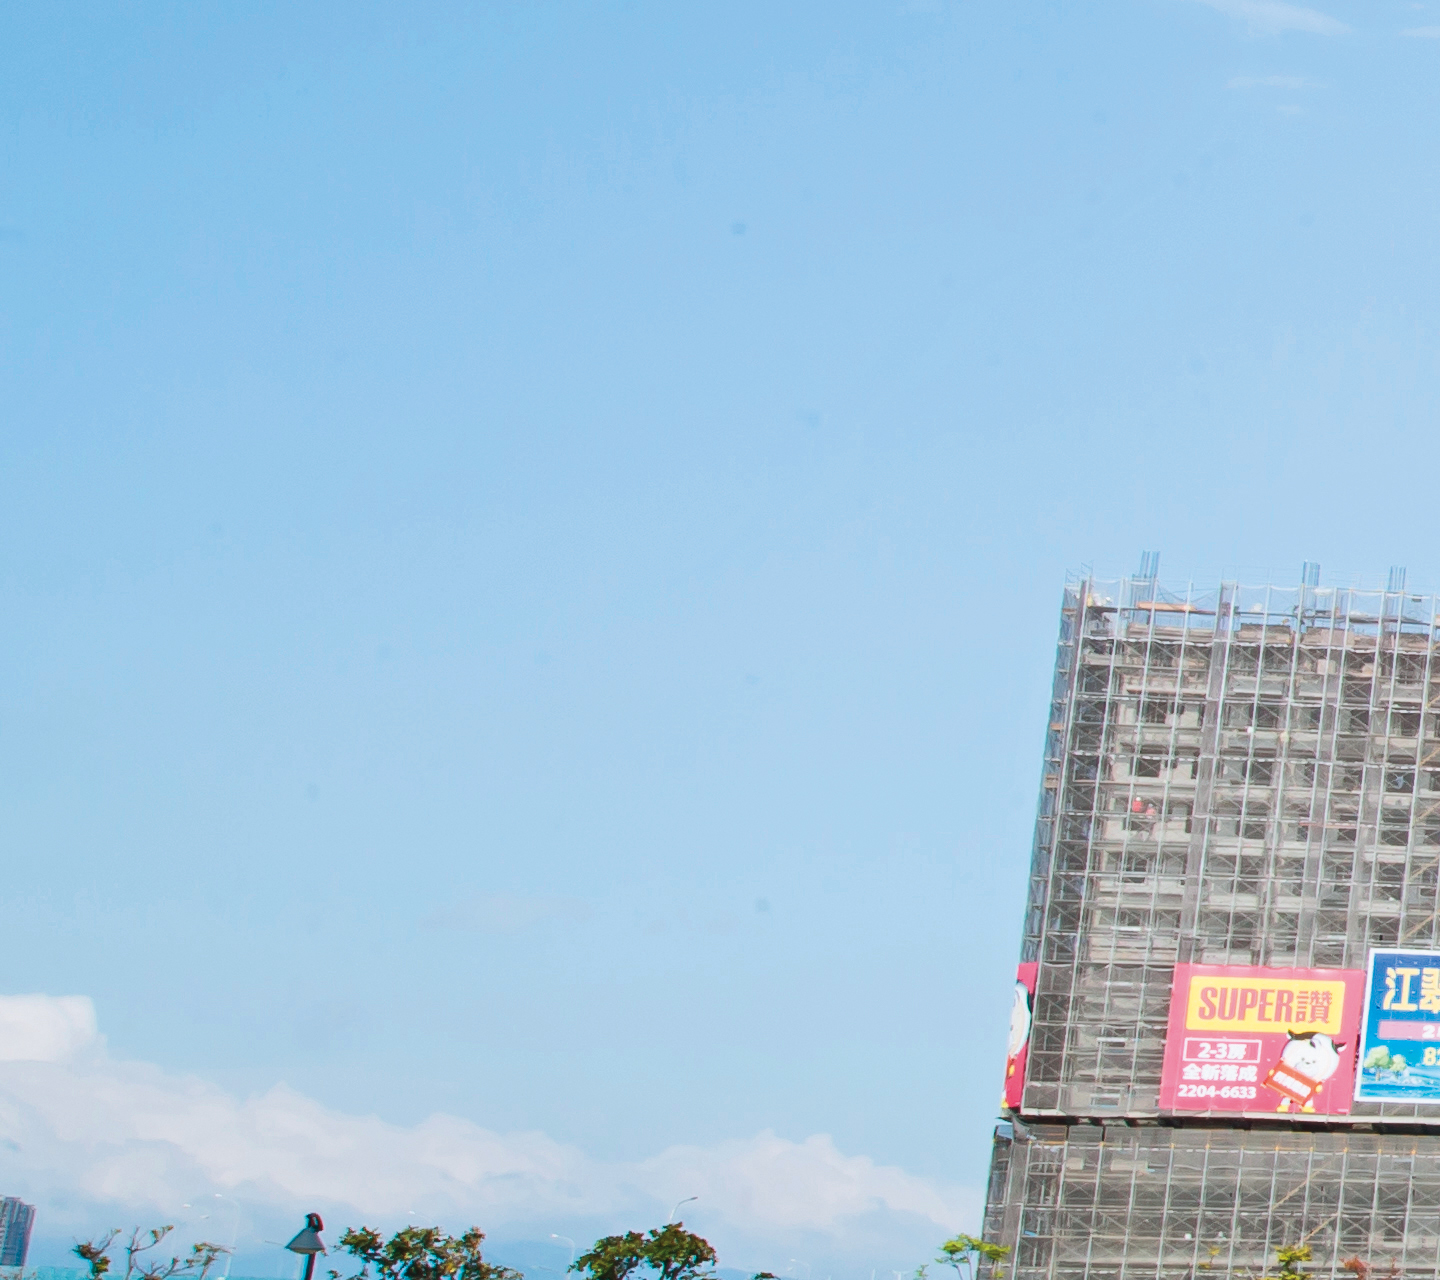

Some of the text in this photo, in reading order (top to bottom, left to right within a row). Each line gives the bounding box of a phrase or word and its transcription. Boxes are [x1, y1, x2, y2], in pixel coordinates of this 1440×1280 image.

[1182, 1064, 1258, 1083] 全新落成
[1178, 1083, 1257, 1100] 2204-6633
